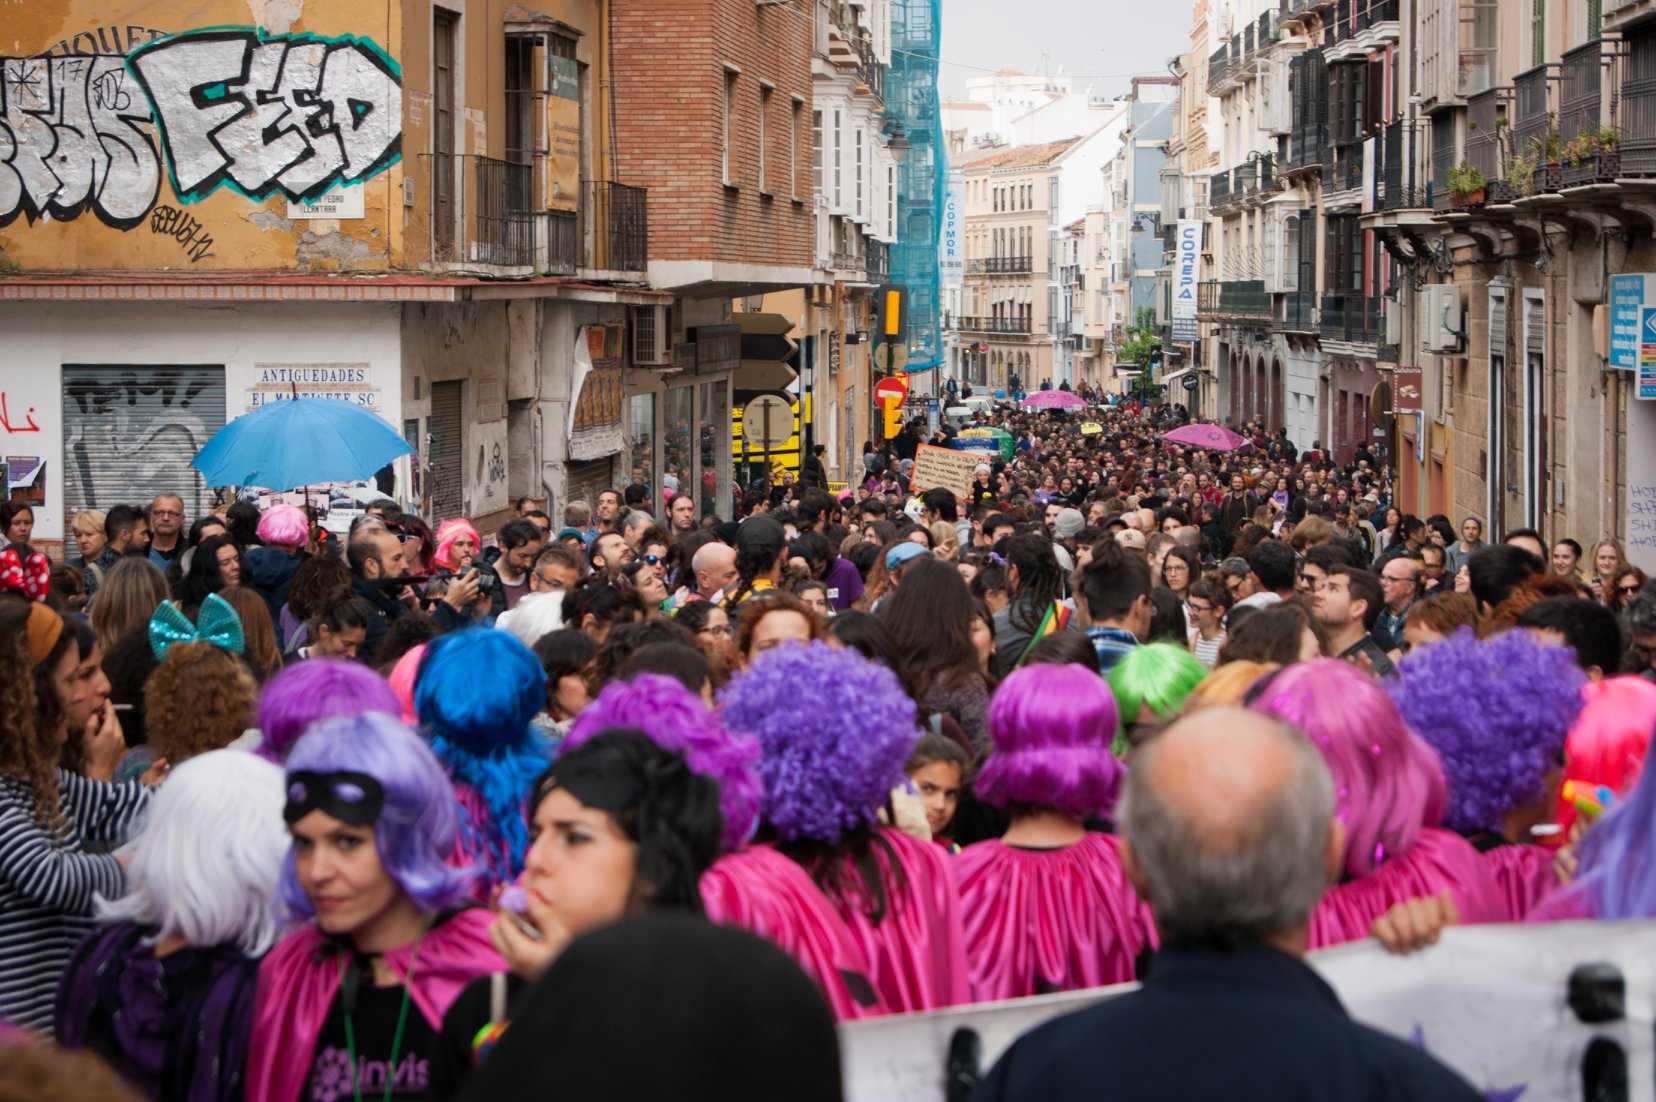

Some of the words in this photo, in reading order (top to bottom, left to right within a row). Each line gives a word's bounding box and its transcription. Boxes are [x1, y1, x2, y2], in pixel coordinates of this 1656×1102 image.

[946, 202, 955, 256] COPMOR
[1178, 227, 1197, 299] COREPA
[358, 392, 375, 406] SC
